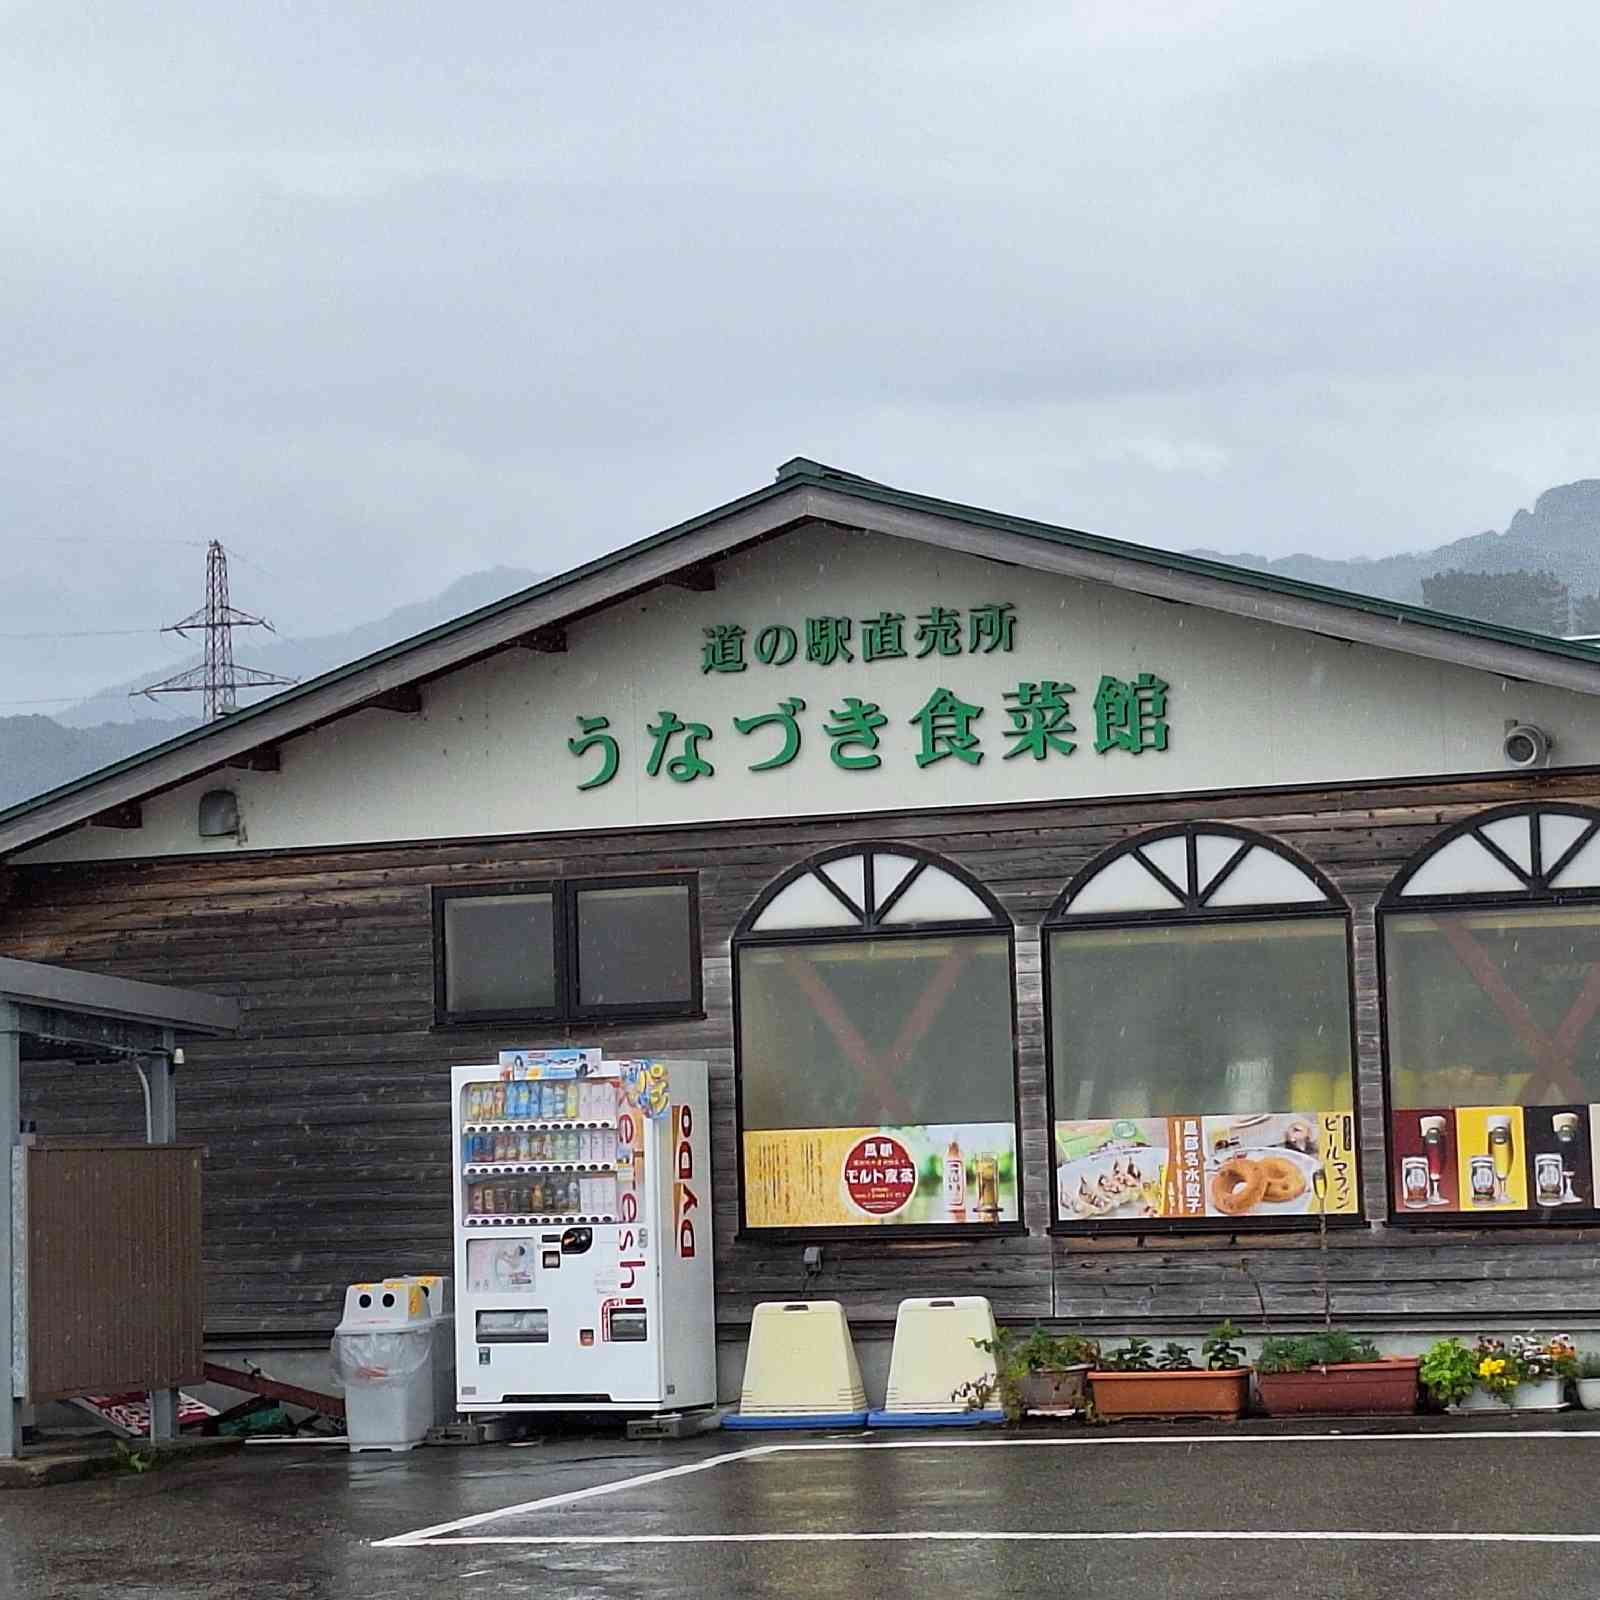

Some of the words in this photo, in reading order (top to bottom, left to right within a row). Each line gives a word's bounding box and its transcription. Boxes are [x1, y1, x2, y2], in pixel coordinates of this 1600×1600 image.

[701, 601, 1017, 675] 道の駅直売所
[567, 672, 1171, 791] うなづき食菜館
[1325, 1115, 1350, 1209] ビールマフィン
